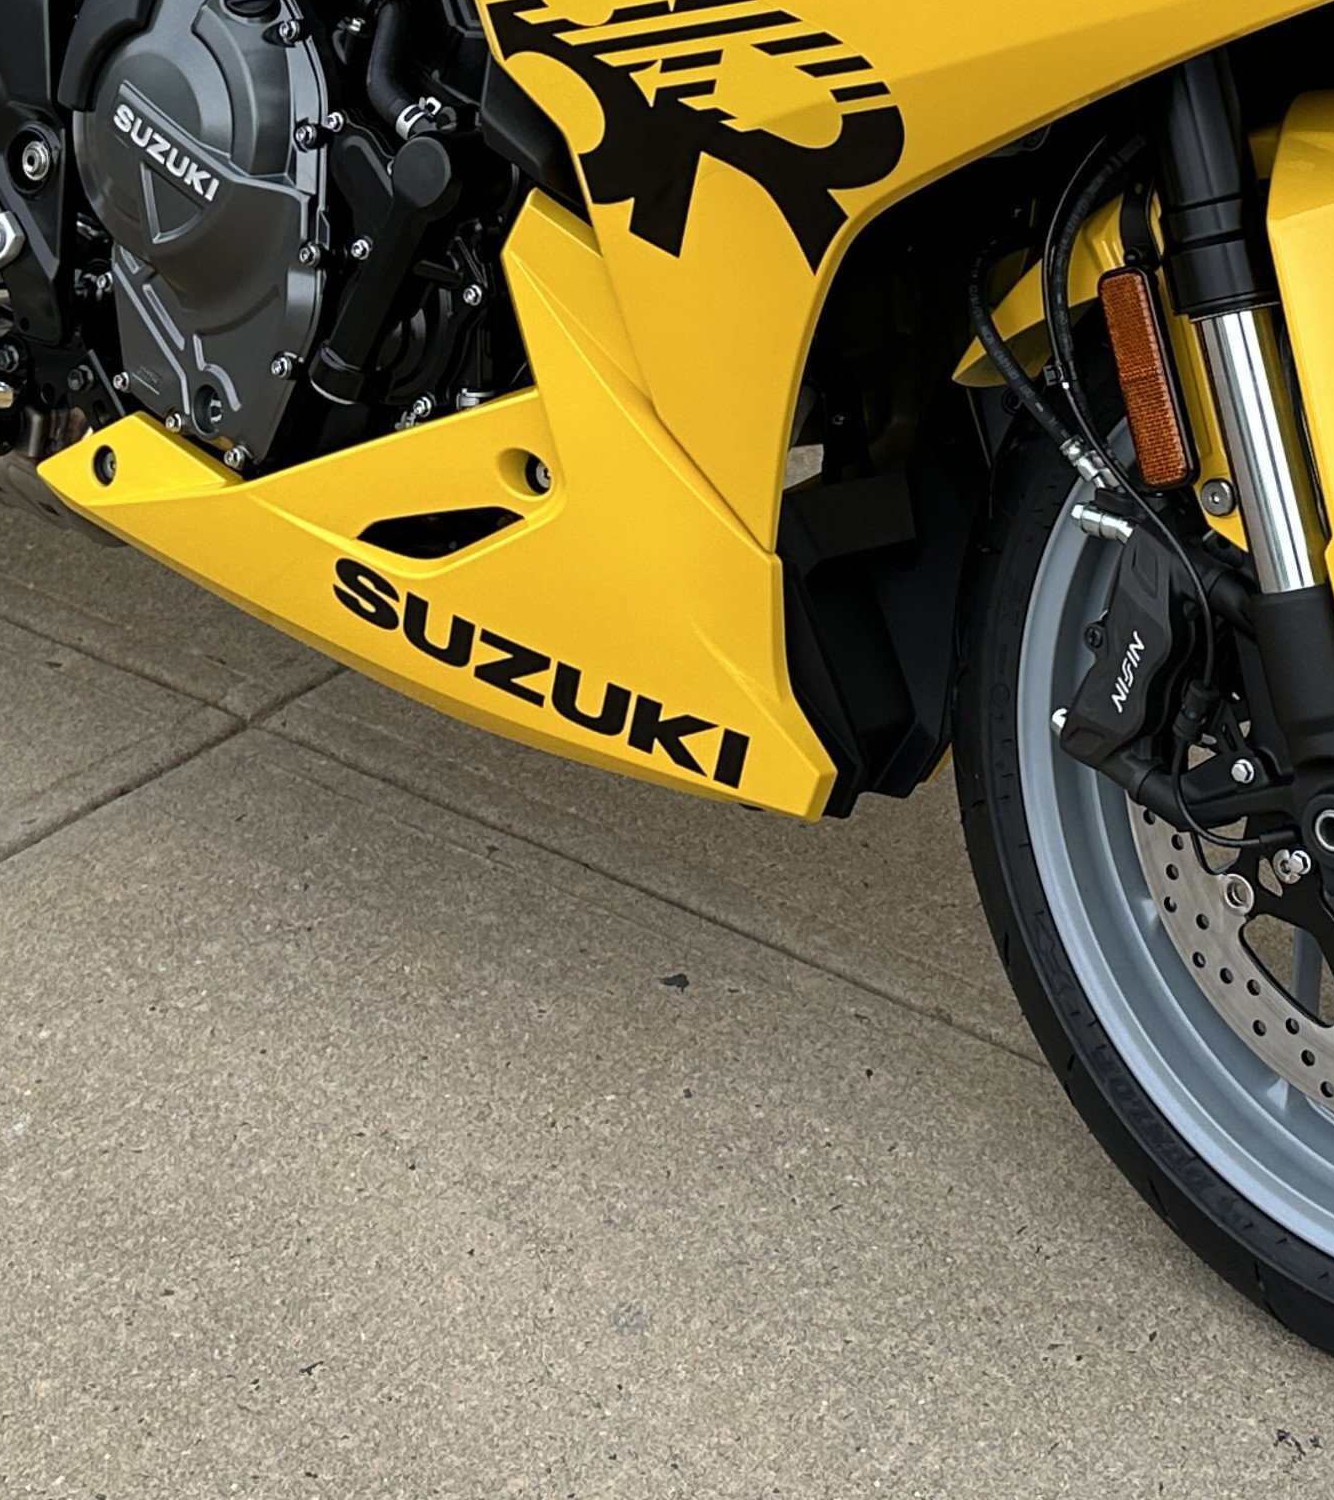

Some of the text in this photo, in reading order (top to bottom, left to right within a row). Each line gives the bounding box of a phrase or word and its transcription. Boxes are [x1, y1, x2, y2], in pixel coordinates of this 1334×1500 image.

[113, 104, 220, 202] SUZUKI
[332, 557, 751, 790] SUZUKI
[1111, 630, 1145, 714] NISSIN
